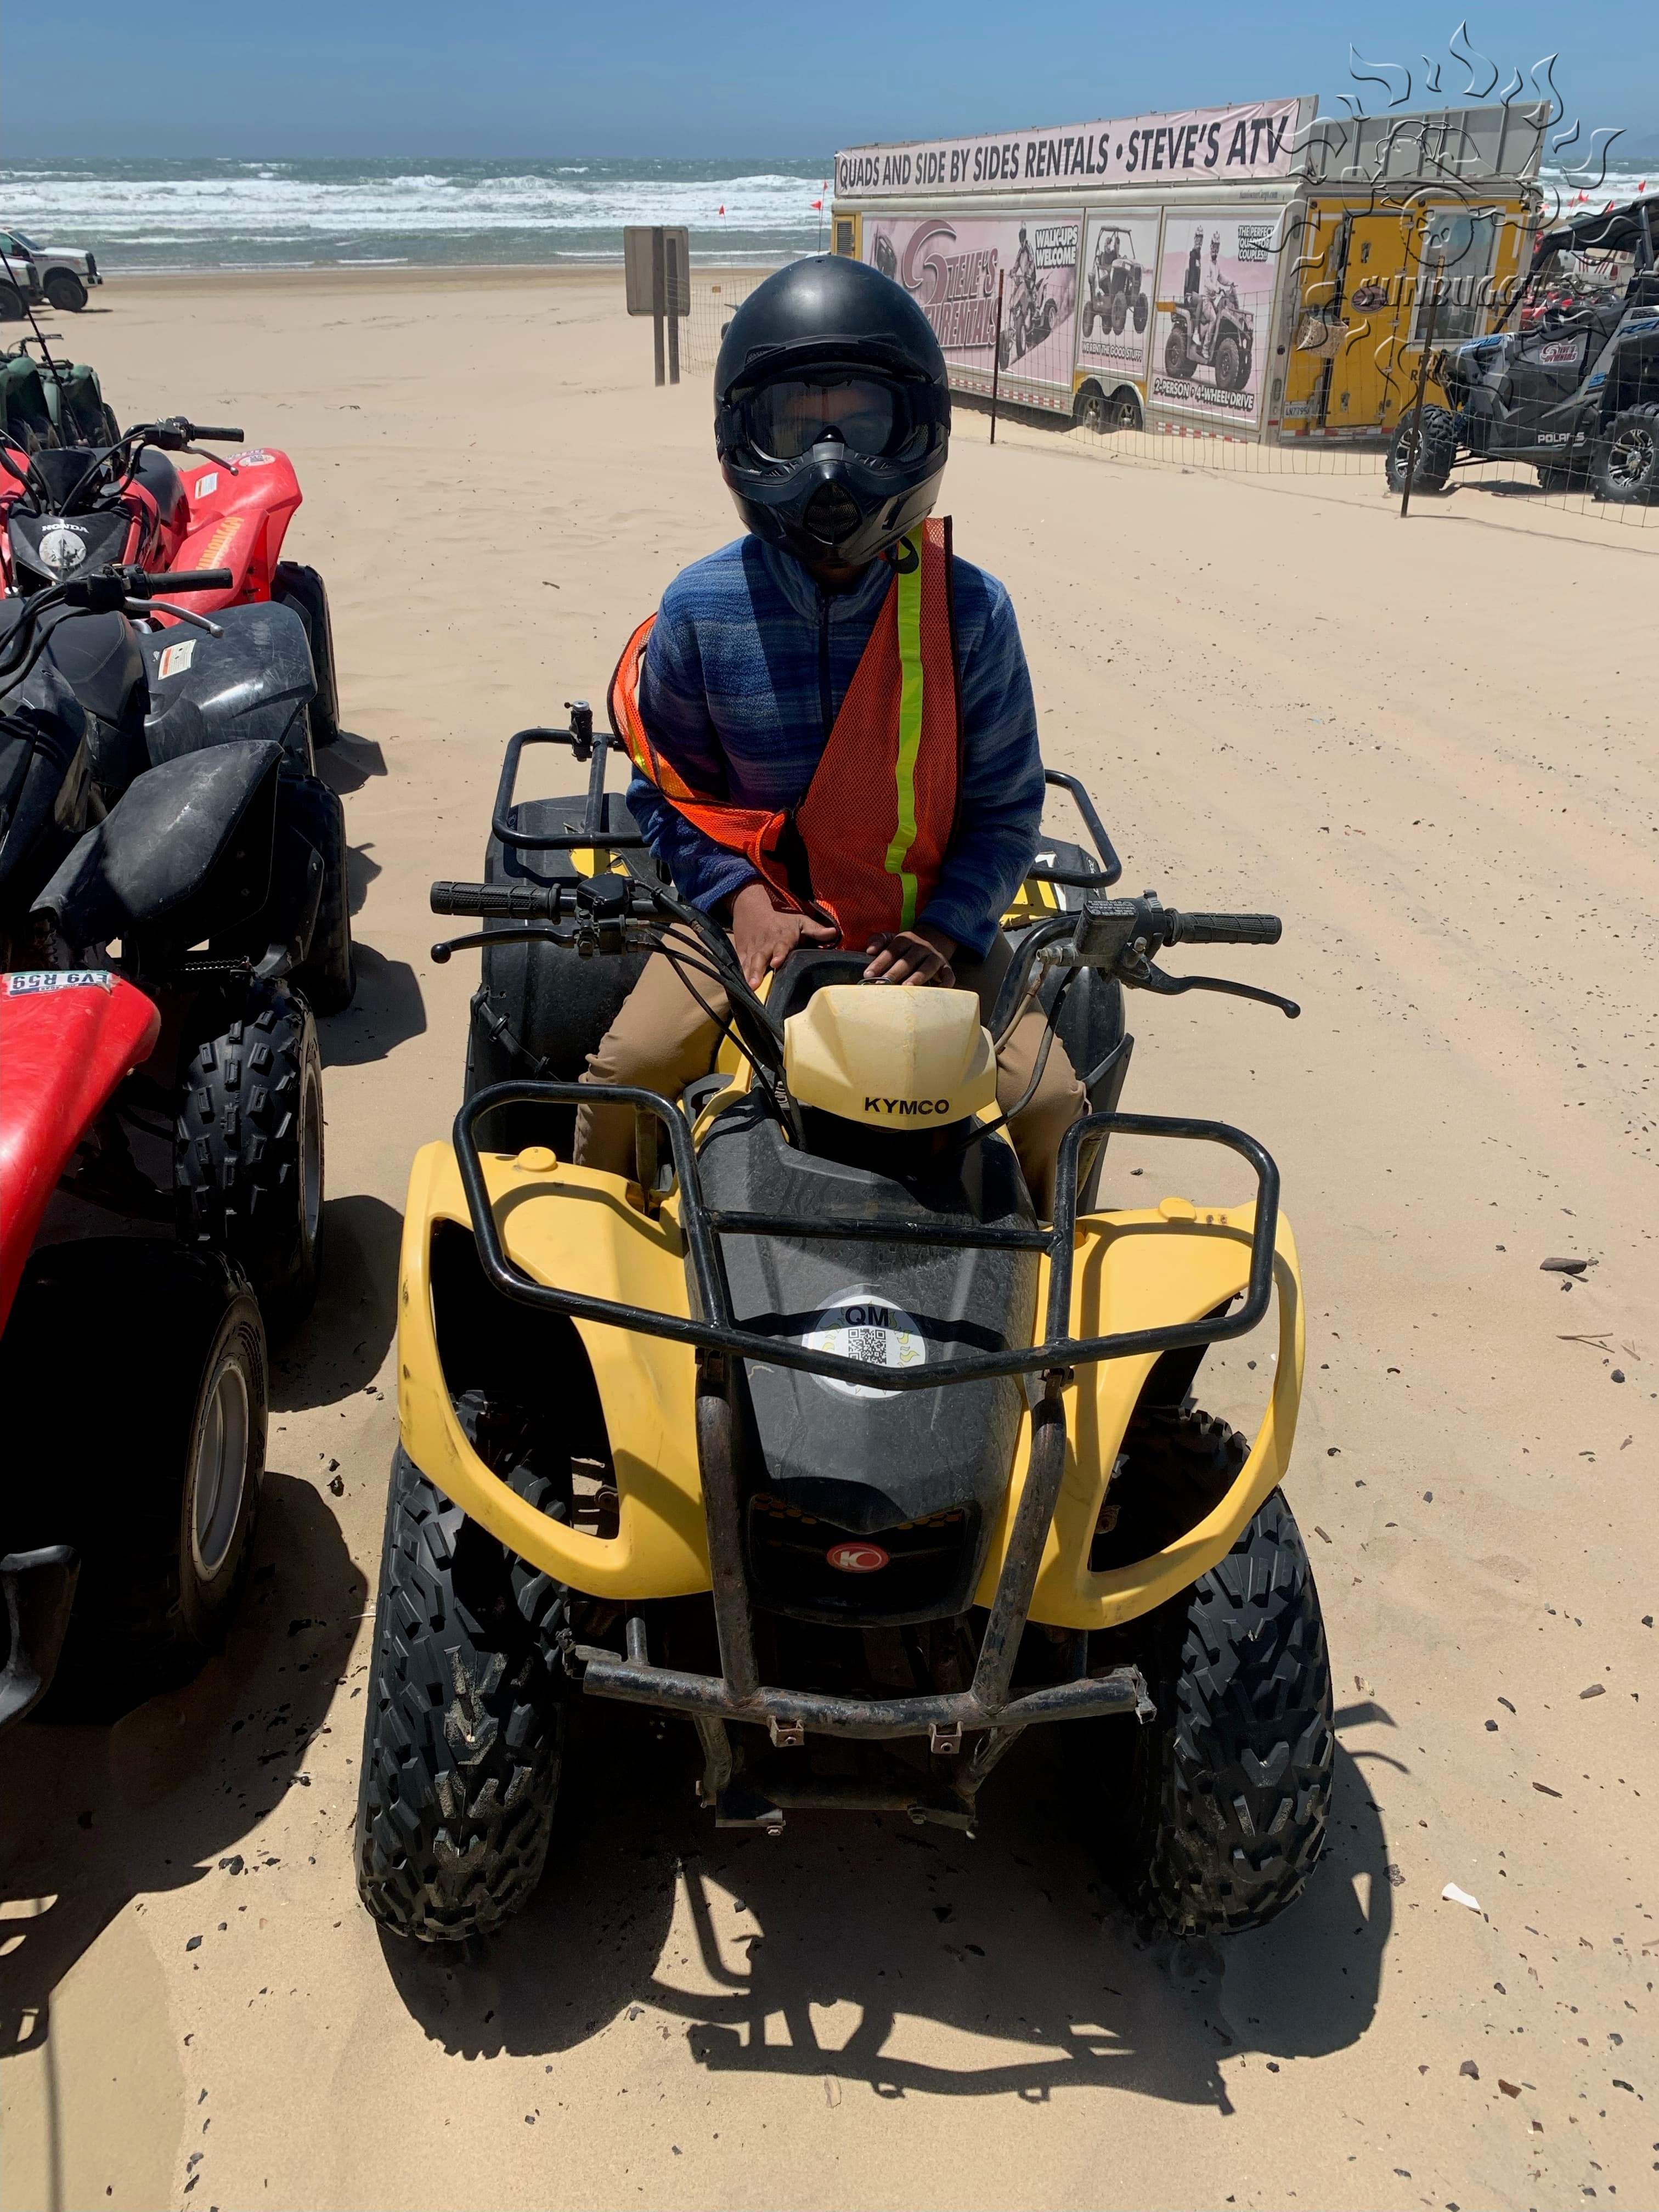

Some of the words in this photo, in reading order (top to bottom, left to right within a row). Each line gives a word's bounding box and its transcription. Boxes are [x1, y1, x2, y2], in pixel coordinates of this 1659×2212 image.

[840, 156, 879, 189] QUADS
[882, 154, 911, 185] AND
[915, 150, 946, 185] SIDE
[950, 148, 970, 182] BY
[973, 143, 1020, 182] SIDES
[1025, 133, 1109, 178] RENTALS
[1126, 122, 1221, 172] STEVE'S
[1226, 115, 1289, 166] ATV
[1036, 225, 1079, 247] WALK-UPS
[1239, 225, 1250, 238] THE
[1250, 225, 1274, 238] PERFECT
[902, 219, 998, 306] STEVE'S
[1036, 246, 1077, 268] WELCOME
[1239, 249, 1268, 261] COUPLES!!
[939, 297, 999, 348] RENTALS
[1110, 345, 1125, 359] GOOD
[1154, 378, 1190, 399] 2-PERSON
[1195, 386, 1230, 407] 4-WHEEL
[1230, 392, 1255, 411] DRIVE
[42, 523, 89, 533] HONDA
[13, 974, 58, 990] R59
[66, 974, 108, 985] EV9
[865, 1097, 950, 1115] KYMCO
[845, 1306, 889, 1327] QM
